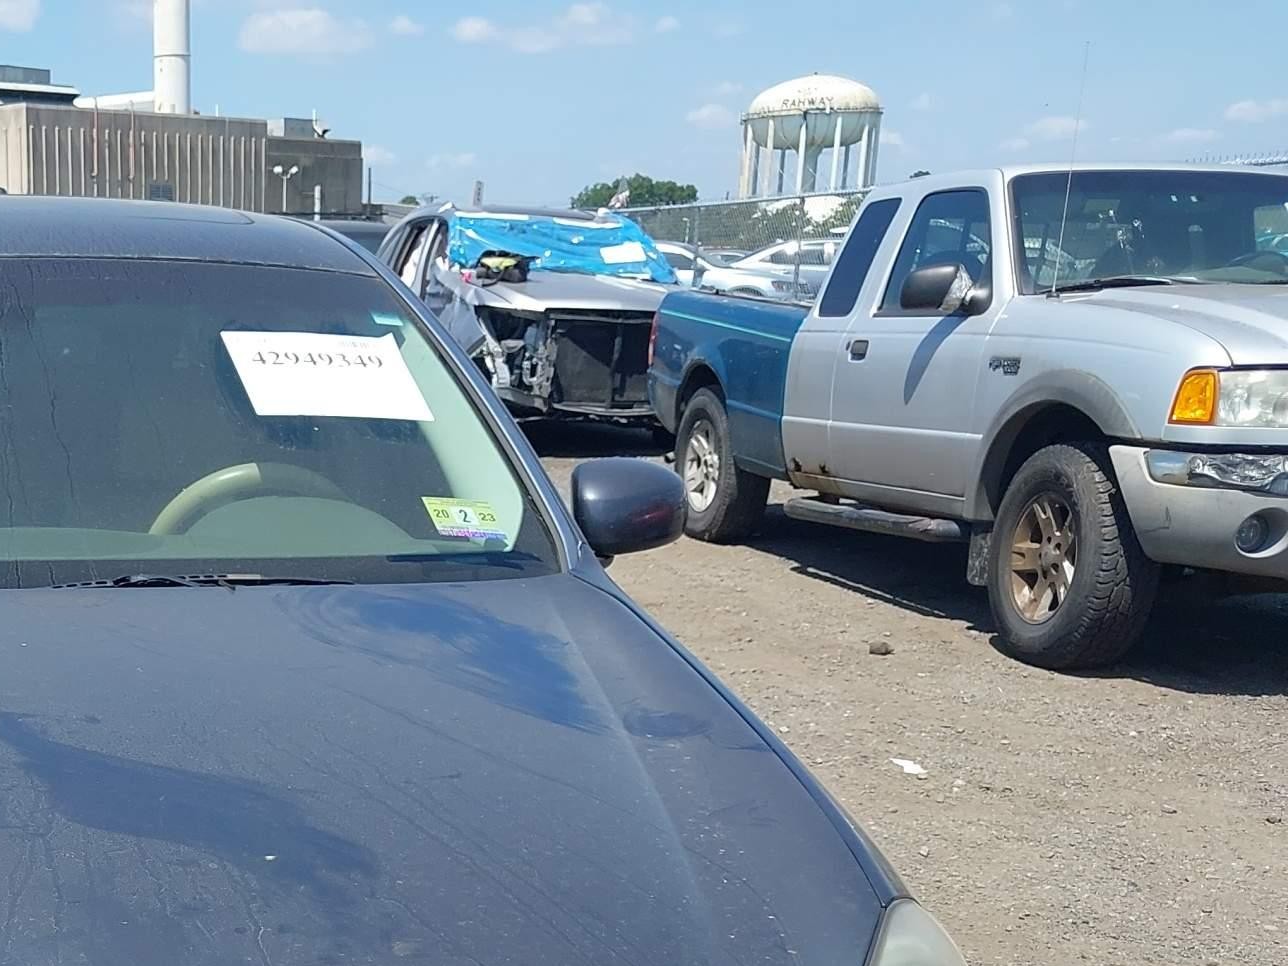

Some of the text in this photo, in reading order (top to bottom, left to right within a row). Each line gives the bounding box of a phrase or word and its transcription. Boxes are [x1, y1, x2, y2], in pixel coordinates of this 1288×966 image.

[781, 96, 834, 109] RAHWAY
[251, 350, 384, 369] 42949349
[433, 508, 496, 523] 20 2 23
